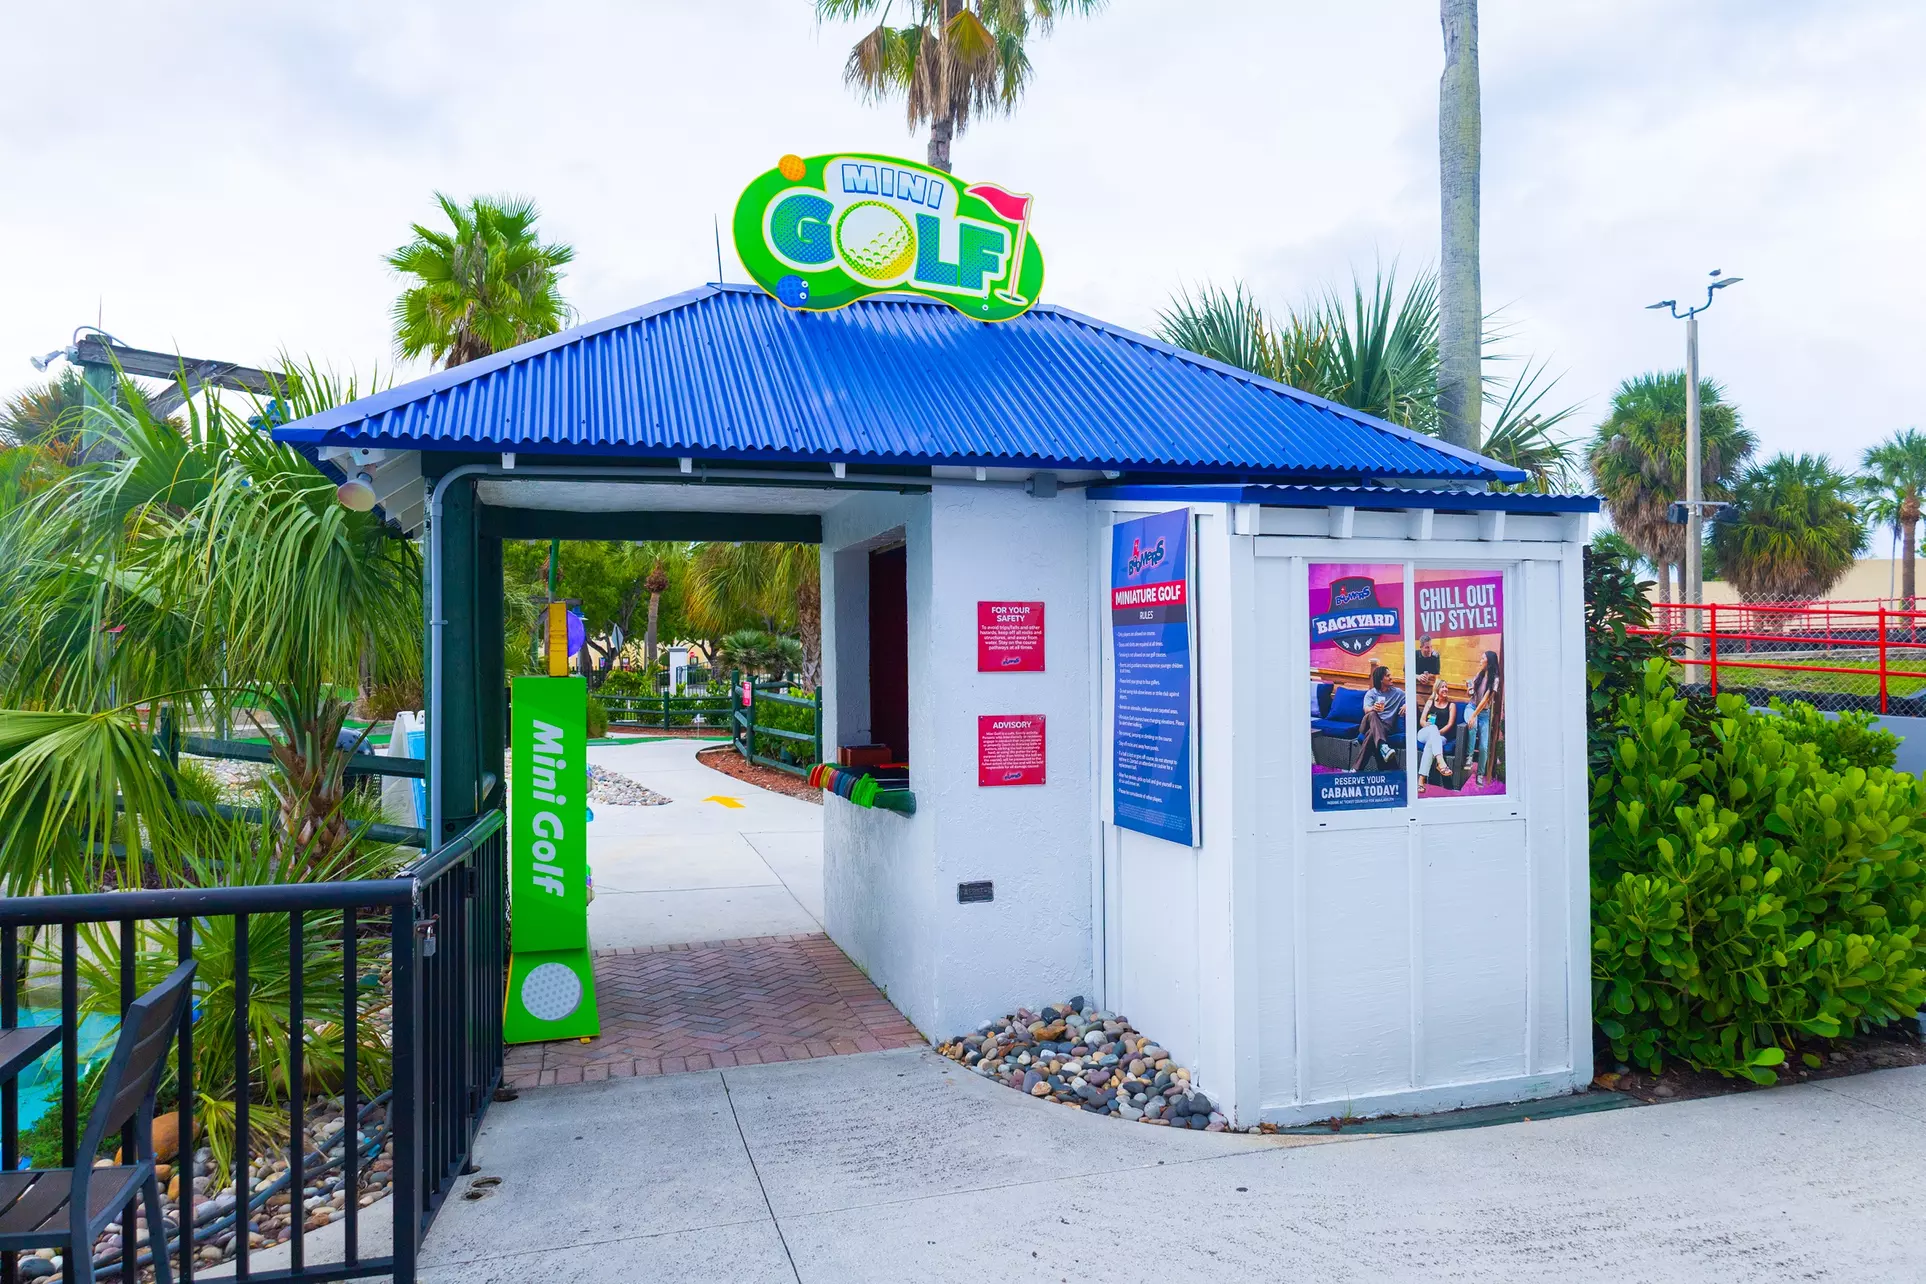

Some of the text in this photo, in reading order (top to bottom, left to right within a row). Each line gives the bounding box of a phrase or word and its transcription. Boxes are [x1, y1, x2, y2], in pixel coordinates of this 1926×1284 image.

[841, 163, 944, 210] MINI
[769, 193, 1005, 290] GOLF
[1115, 584, 1182, 606] MINIATURE GOLF
[1419, 583, 1496, 611] CHILL OUT
[991, 606, 1030, 614] FOR YOUR
[996, 614, 1025, 622] SAFETY
[1139, 610, 1154, 620] RULES
[1420, 606, 1498, 633] VIP STYLE!
[1316, 613, 1395, 635] BACKYARD
[992, 721, 1032, 729] ADVISORY
[1321, 784, 1399, 799] CABANA TODAY!
[1334, 775, 1386, 786] RESERVE YOUR
[531, 719, 567, 898] Mini Golf
